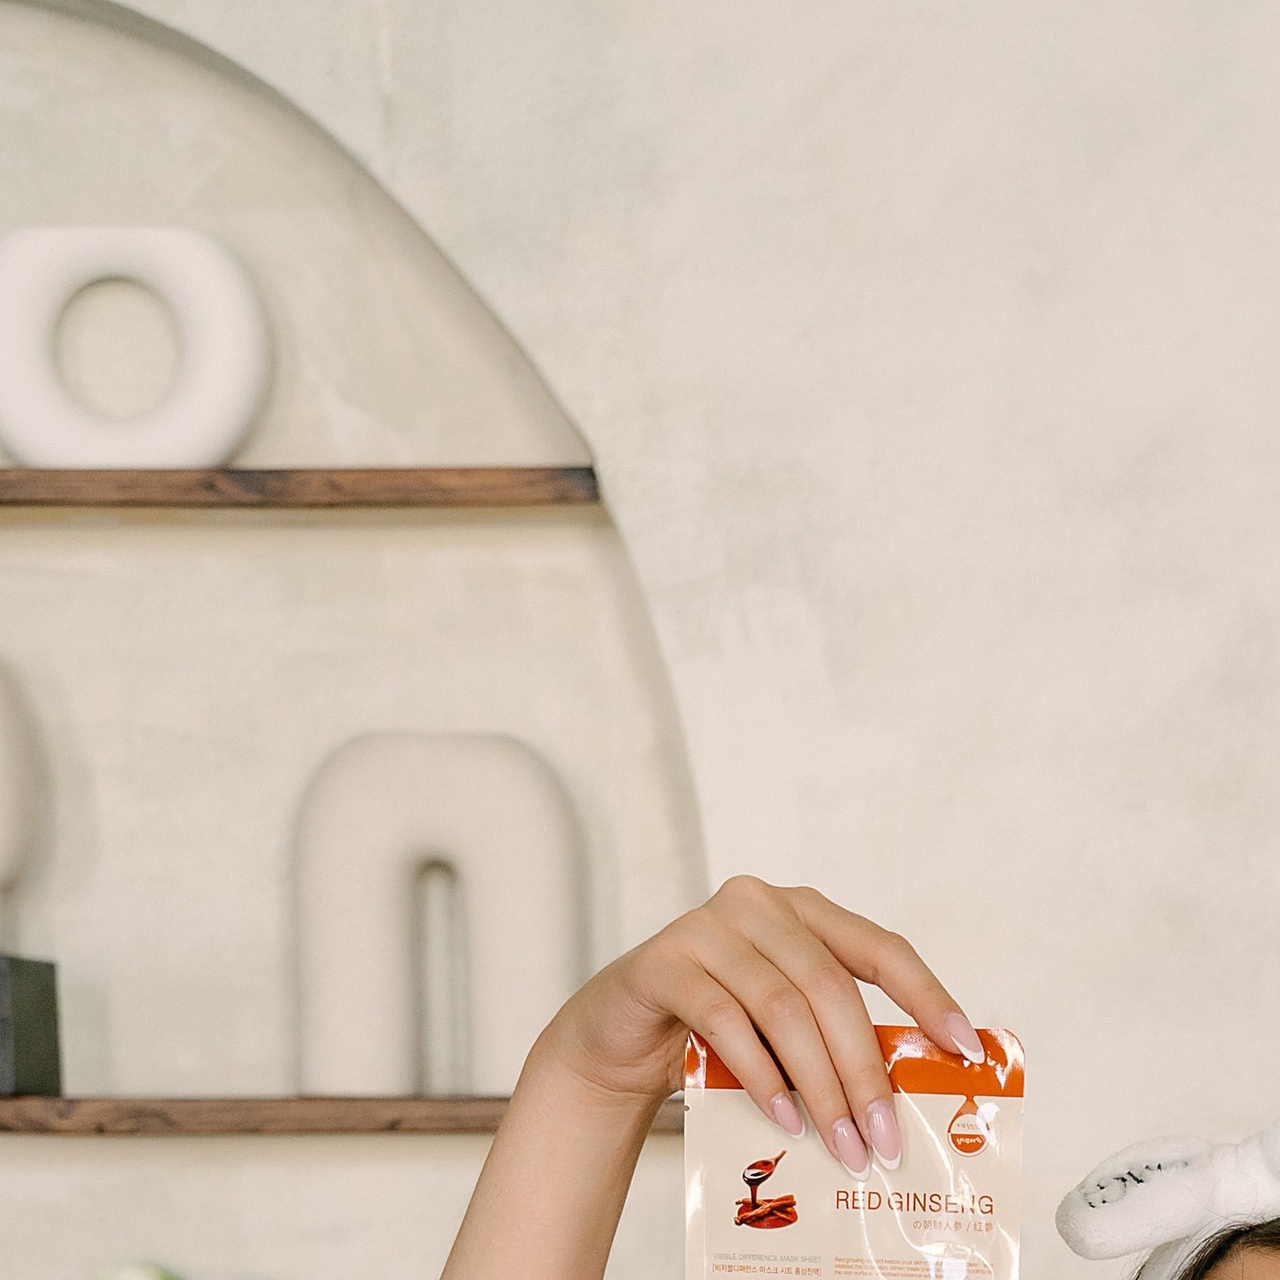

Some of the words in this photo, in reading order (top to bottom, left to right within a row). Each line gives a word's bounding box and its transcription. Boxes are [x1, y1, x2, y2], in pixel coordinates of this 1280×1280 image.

[836, 1190, 882, 1211] RED
[888, 1192, 994, 1215] GINSENG
[713, 1253, 737, 1261] VISIBLE
[738, 1254, 778, 1262] DIFFERENCE
[780, 1255, 799, 1263] MASK
